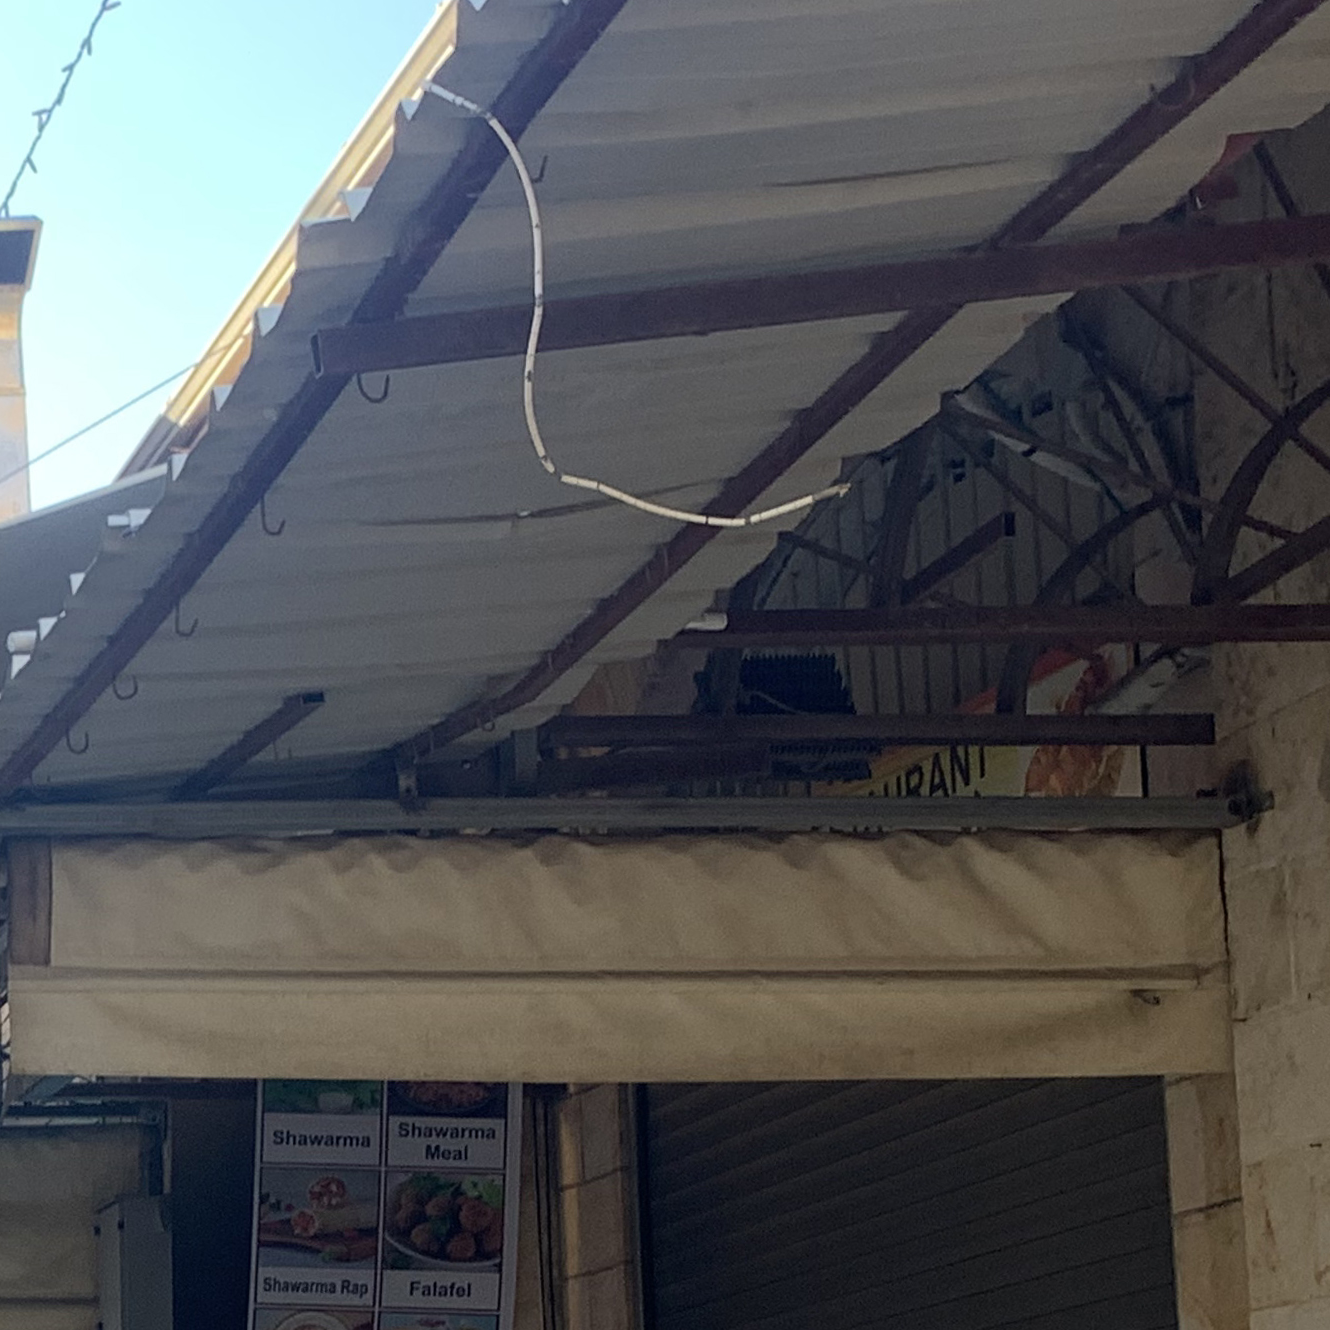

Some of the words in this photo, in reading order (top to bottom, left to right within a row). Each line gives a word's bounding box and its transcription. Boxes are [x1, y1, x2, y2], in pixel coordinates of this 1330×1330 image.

[272, 1130, 371, 1148] Shawarma
[397, 1122, 496, 1140] Shawarma
[424, 1144, 469, 1161] Meal
[262, 1276, 337, 1294] Shawarma
[340, 1279, 369, 1297] Rap
[409, 1281, 472, 1298] Falafel
